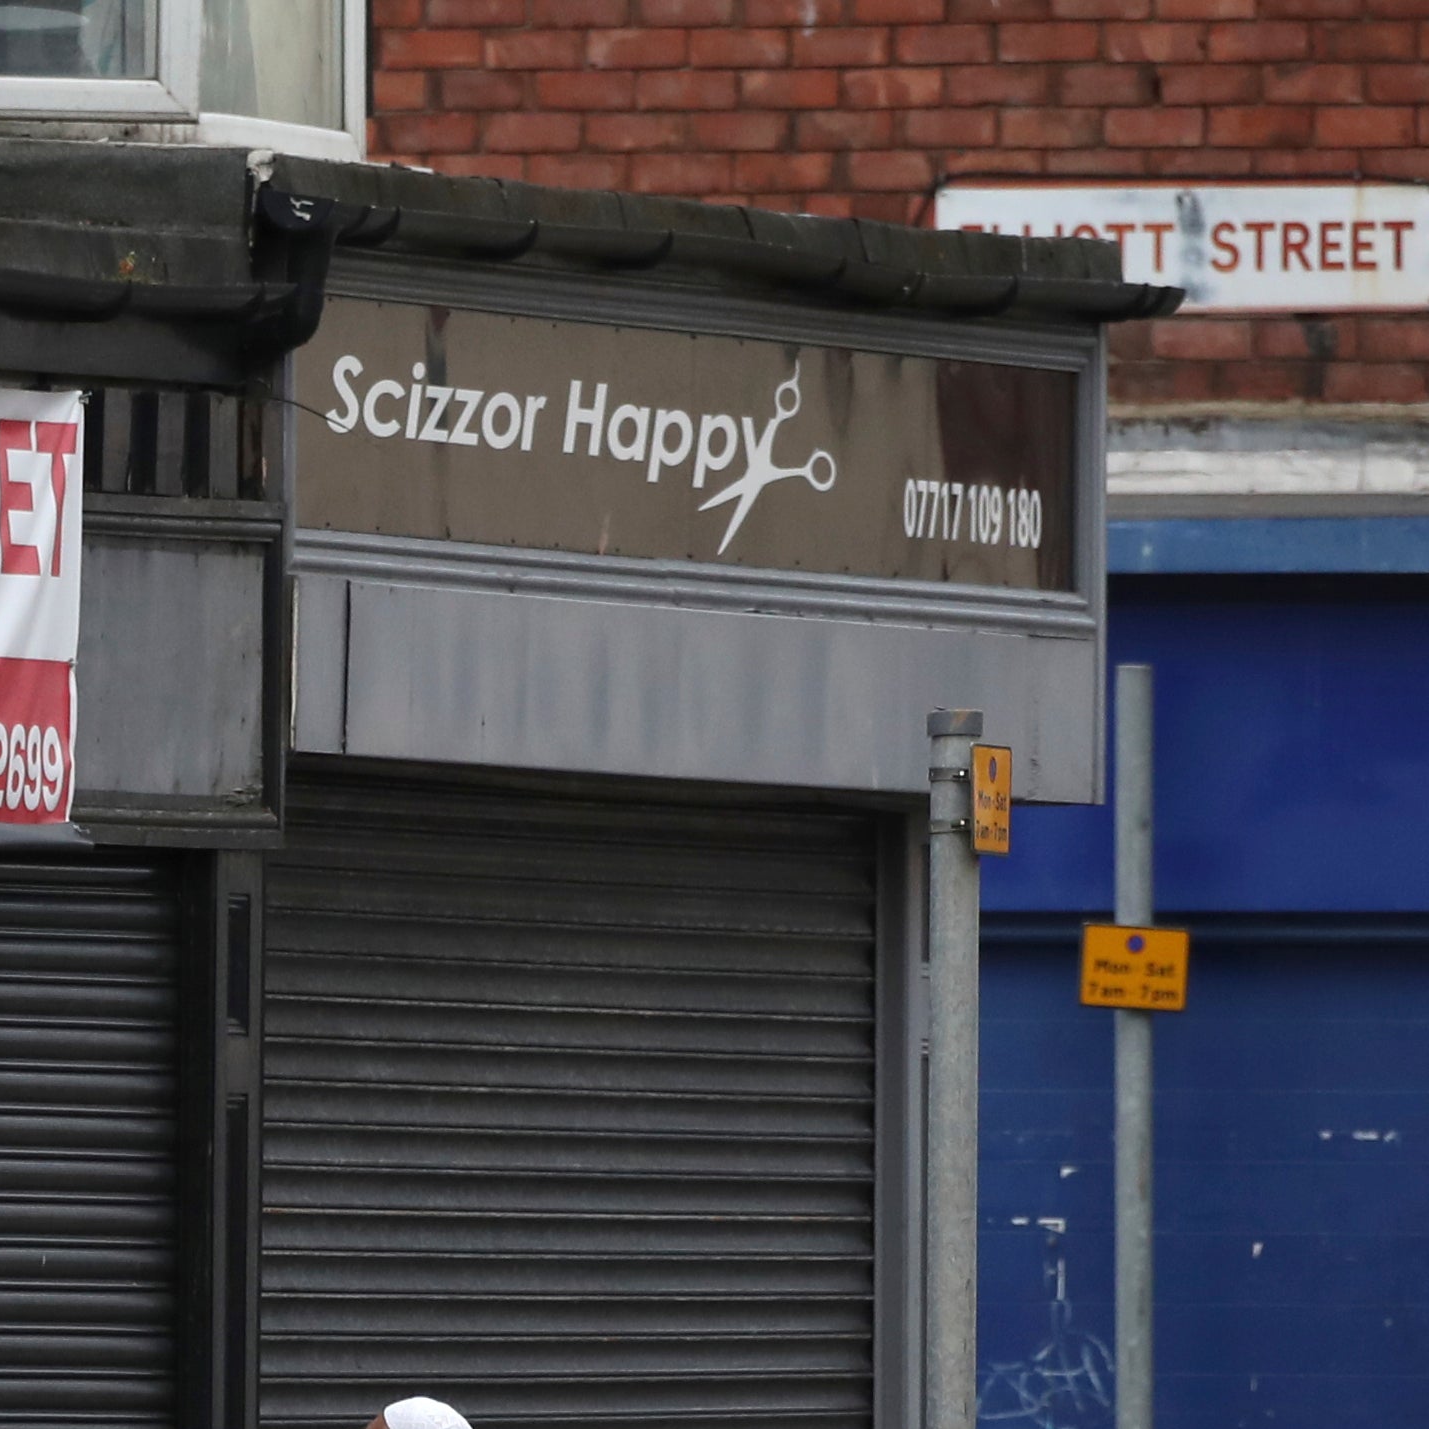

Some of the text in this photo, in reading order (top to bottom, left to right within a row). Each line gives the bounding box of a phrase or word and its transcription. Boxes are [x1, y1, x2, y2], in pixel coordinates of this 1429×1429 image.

[1210, 220, 1415, 273] STREET
[325, 354, 802, 555] Scizzor Happy
[903, 478, 1042, 549] 07717 109 180
